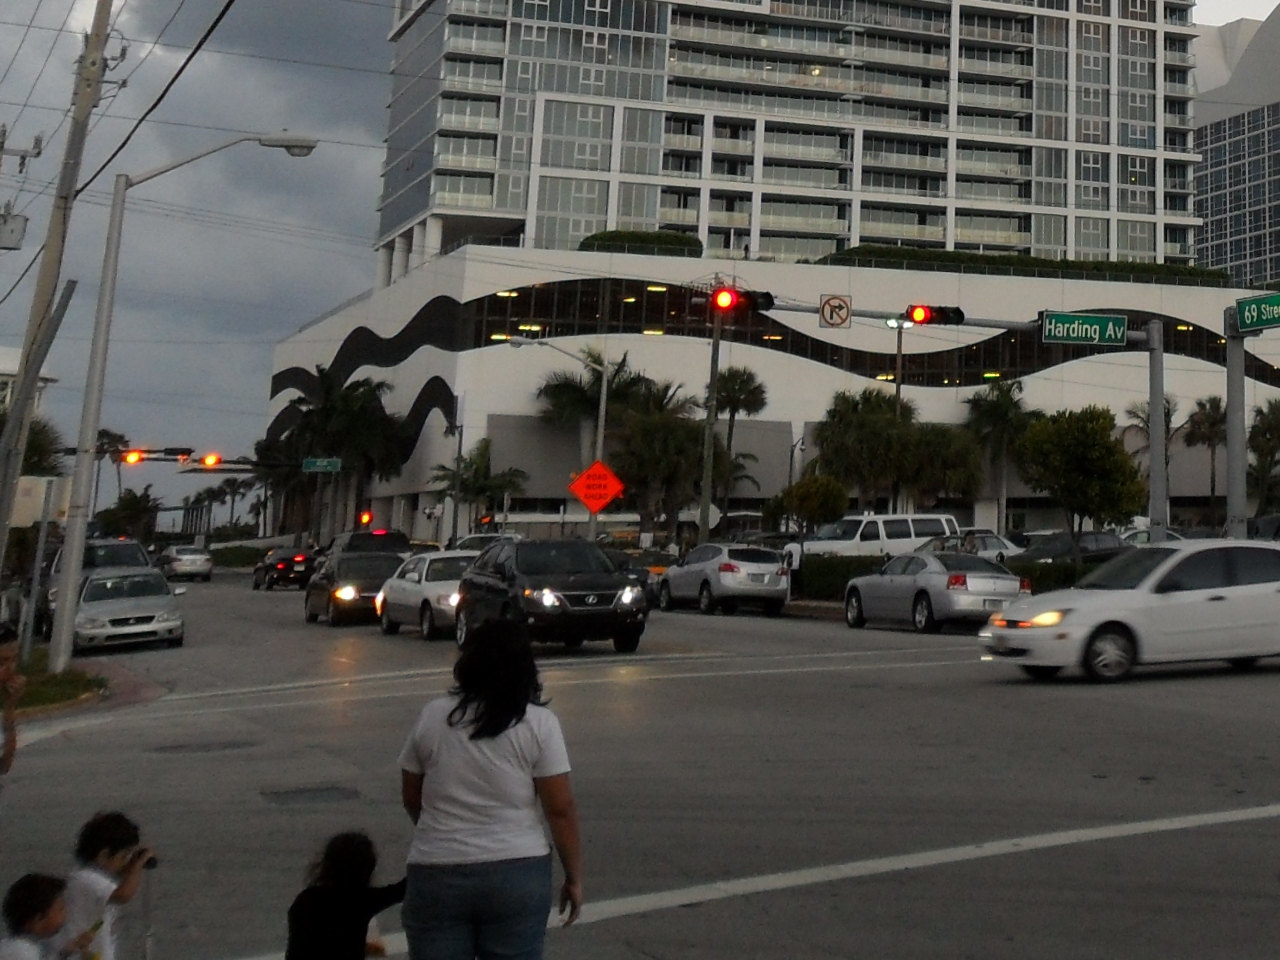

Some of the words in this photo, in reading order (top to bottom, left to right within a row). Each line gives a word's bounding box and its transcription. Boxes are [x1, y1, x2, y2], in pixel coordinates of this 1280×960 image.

[1244, 303, 1258, 324] 69
[1045, 320, 1099, 343] Harding
[1105, 321, 1125, 339] Av
